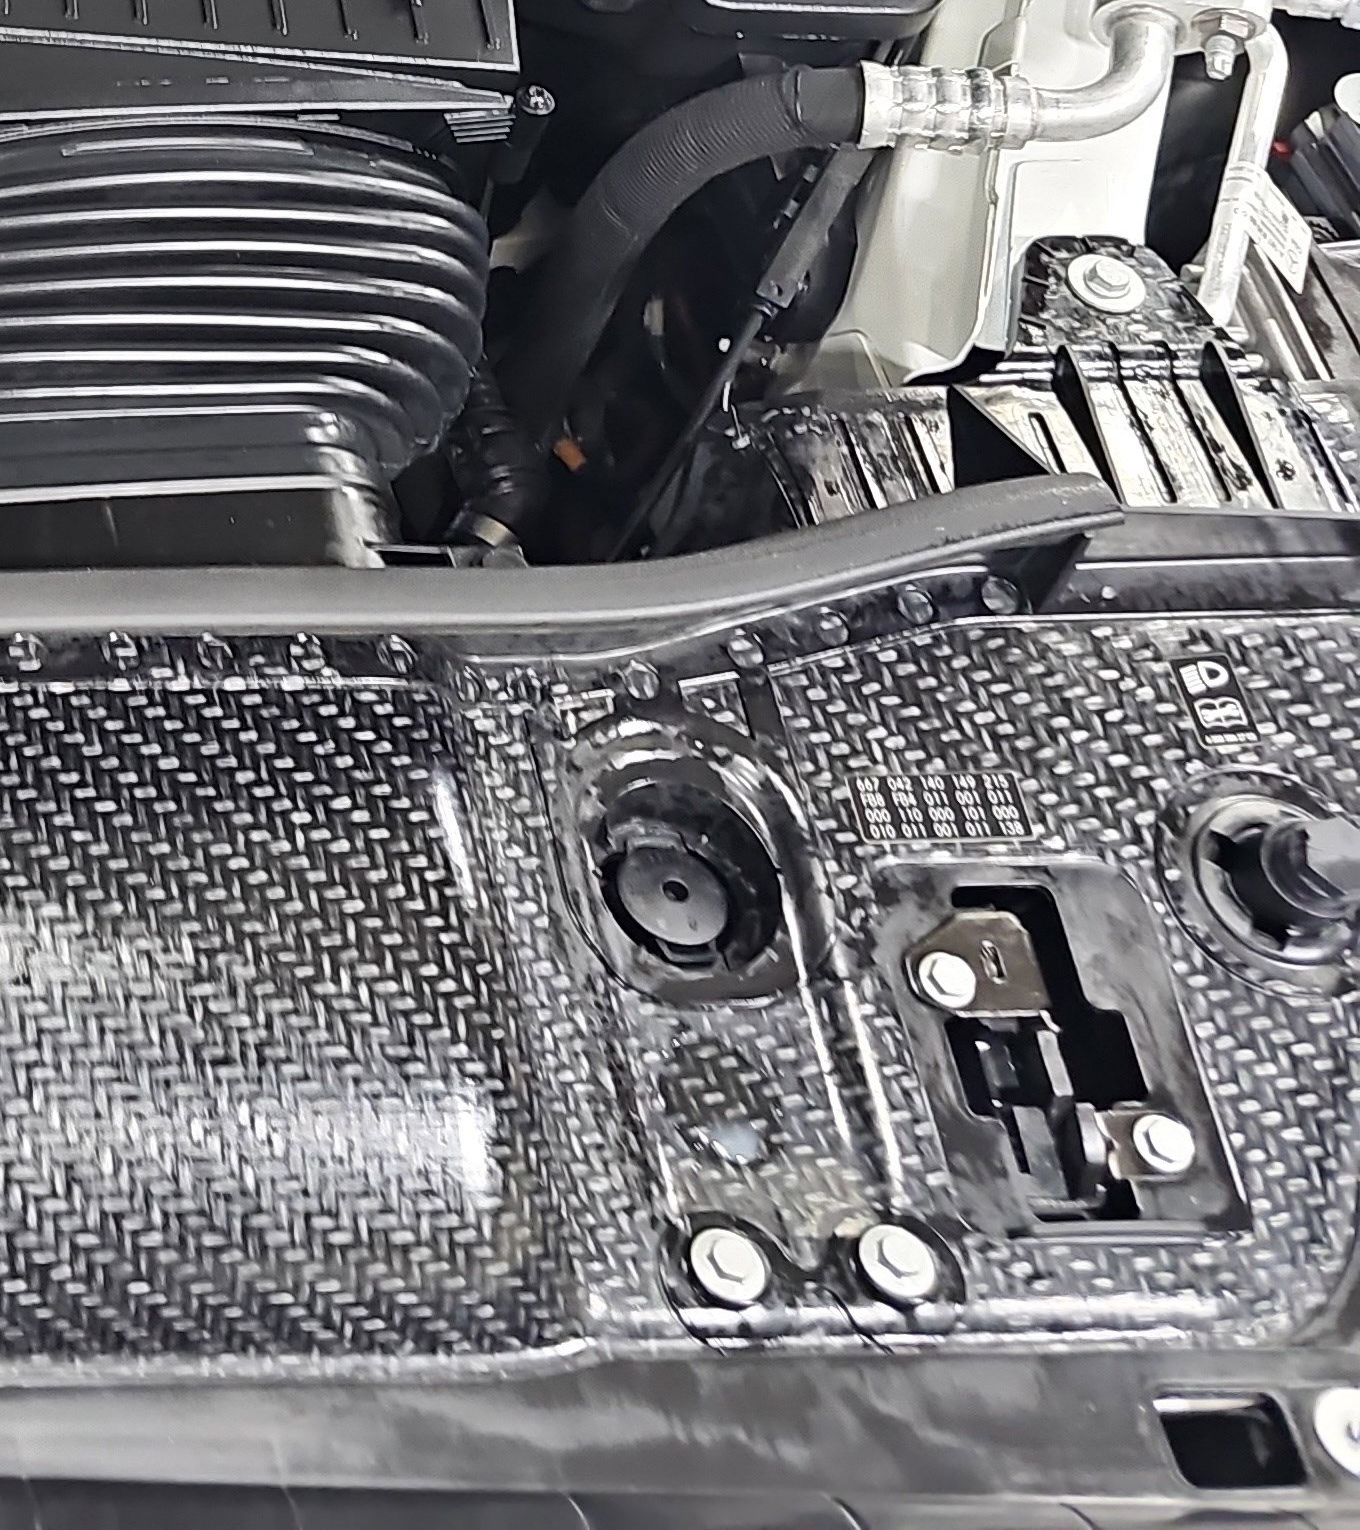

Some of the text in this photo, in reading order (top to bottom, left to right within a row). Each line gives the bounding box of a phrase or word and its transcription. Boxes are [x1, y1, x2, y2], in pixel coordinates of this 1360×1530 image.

[886, 775, 913, 791] 042
[919, 774, 945, 790] 140
[951, 774, 976, 790] 149
[981, 773, 1009, 789] 215
[922, 790, 949, 806] 011
[954, 789, 981, 805] 001
[986, 788, 1014, 804] 011
[865, 804, 1020, 823] 000 110 000 101 000
[869, 820, 1025, 839] 010 011 001 011 138
